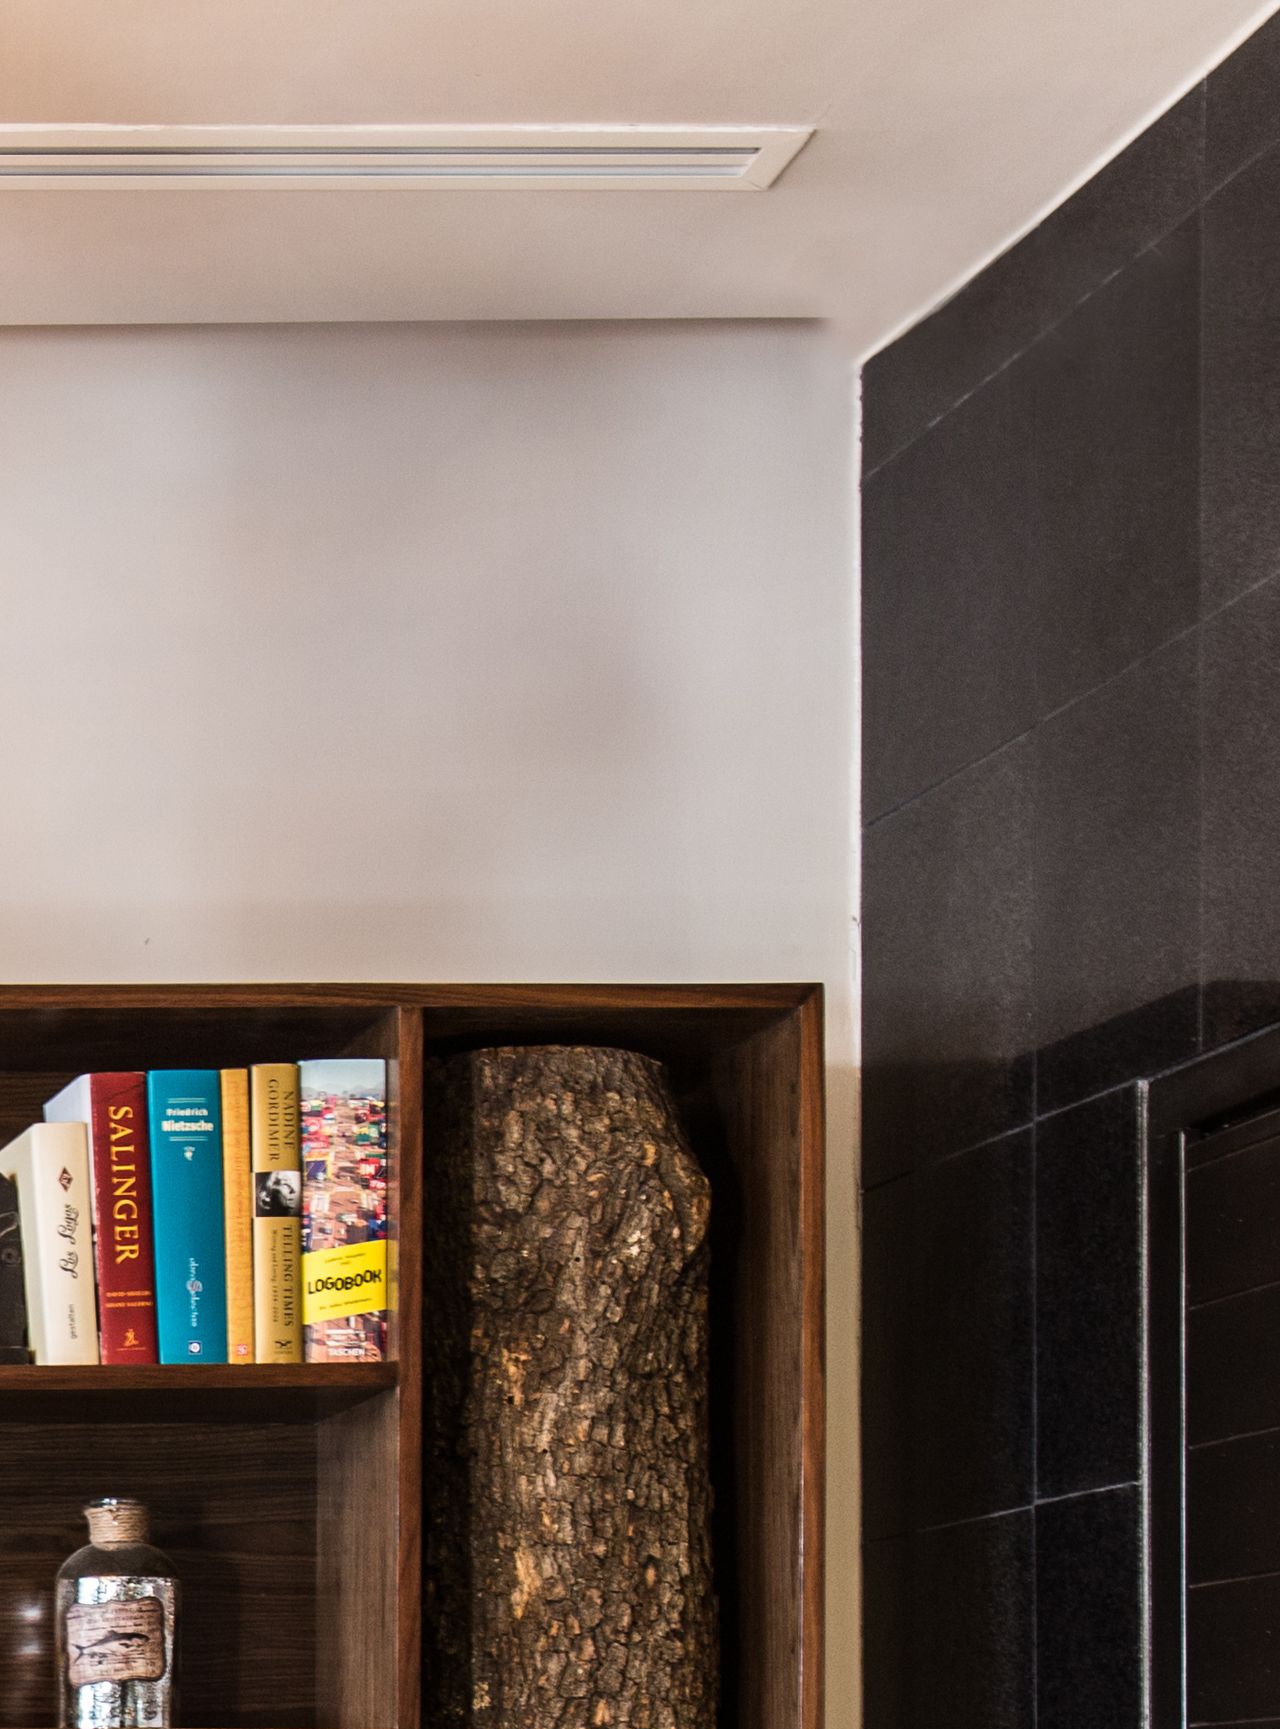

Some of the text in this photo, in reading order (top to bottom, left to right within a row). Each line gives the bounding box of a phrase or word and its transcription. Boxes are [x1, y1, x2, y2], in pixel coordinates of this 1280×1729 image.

[161, 1120, 214, 1132] Nietzsche
[166, 1108, 209, 1117] Friedrich
[267, 1079, 281, 1161] GORDIMER
[282, 1091, 295, 1151] NADINE
[108, 1105, 140, 1266] SALINGER
[57, 1204, 80, 1279] Los Logos
[282, 1225, 294, 1328] TELLING TIMES
[307, 1269, 382, 1295] LOGOBOOK
[67, 1304, 78, 1340] gestalten
